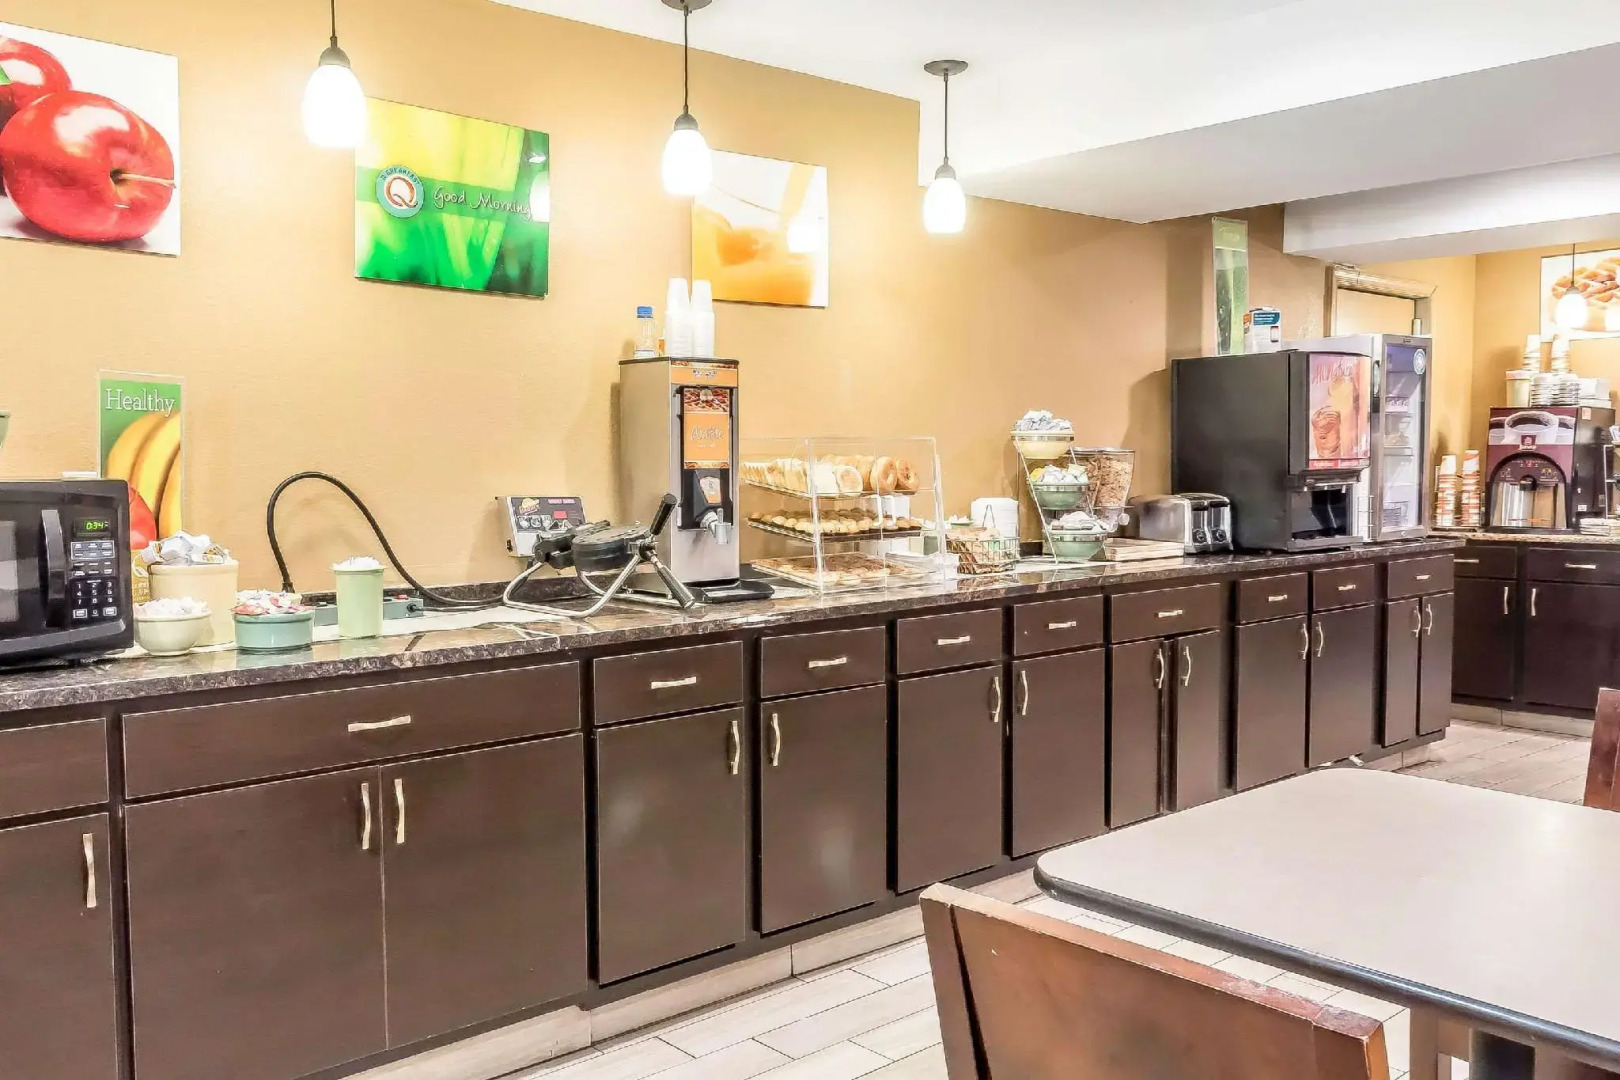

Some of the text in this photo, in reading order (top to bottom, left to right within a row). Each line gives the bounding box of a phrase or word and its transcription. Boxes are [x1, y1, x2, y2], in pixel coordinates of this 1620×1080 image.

[385, 167, 420, 185] BREAKFAST
[385, 176, 418, 208] Q
[433, 185, 533, 221] Good Morning
[105, 388, 176, 417] Healthy
